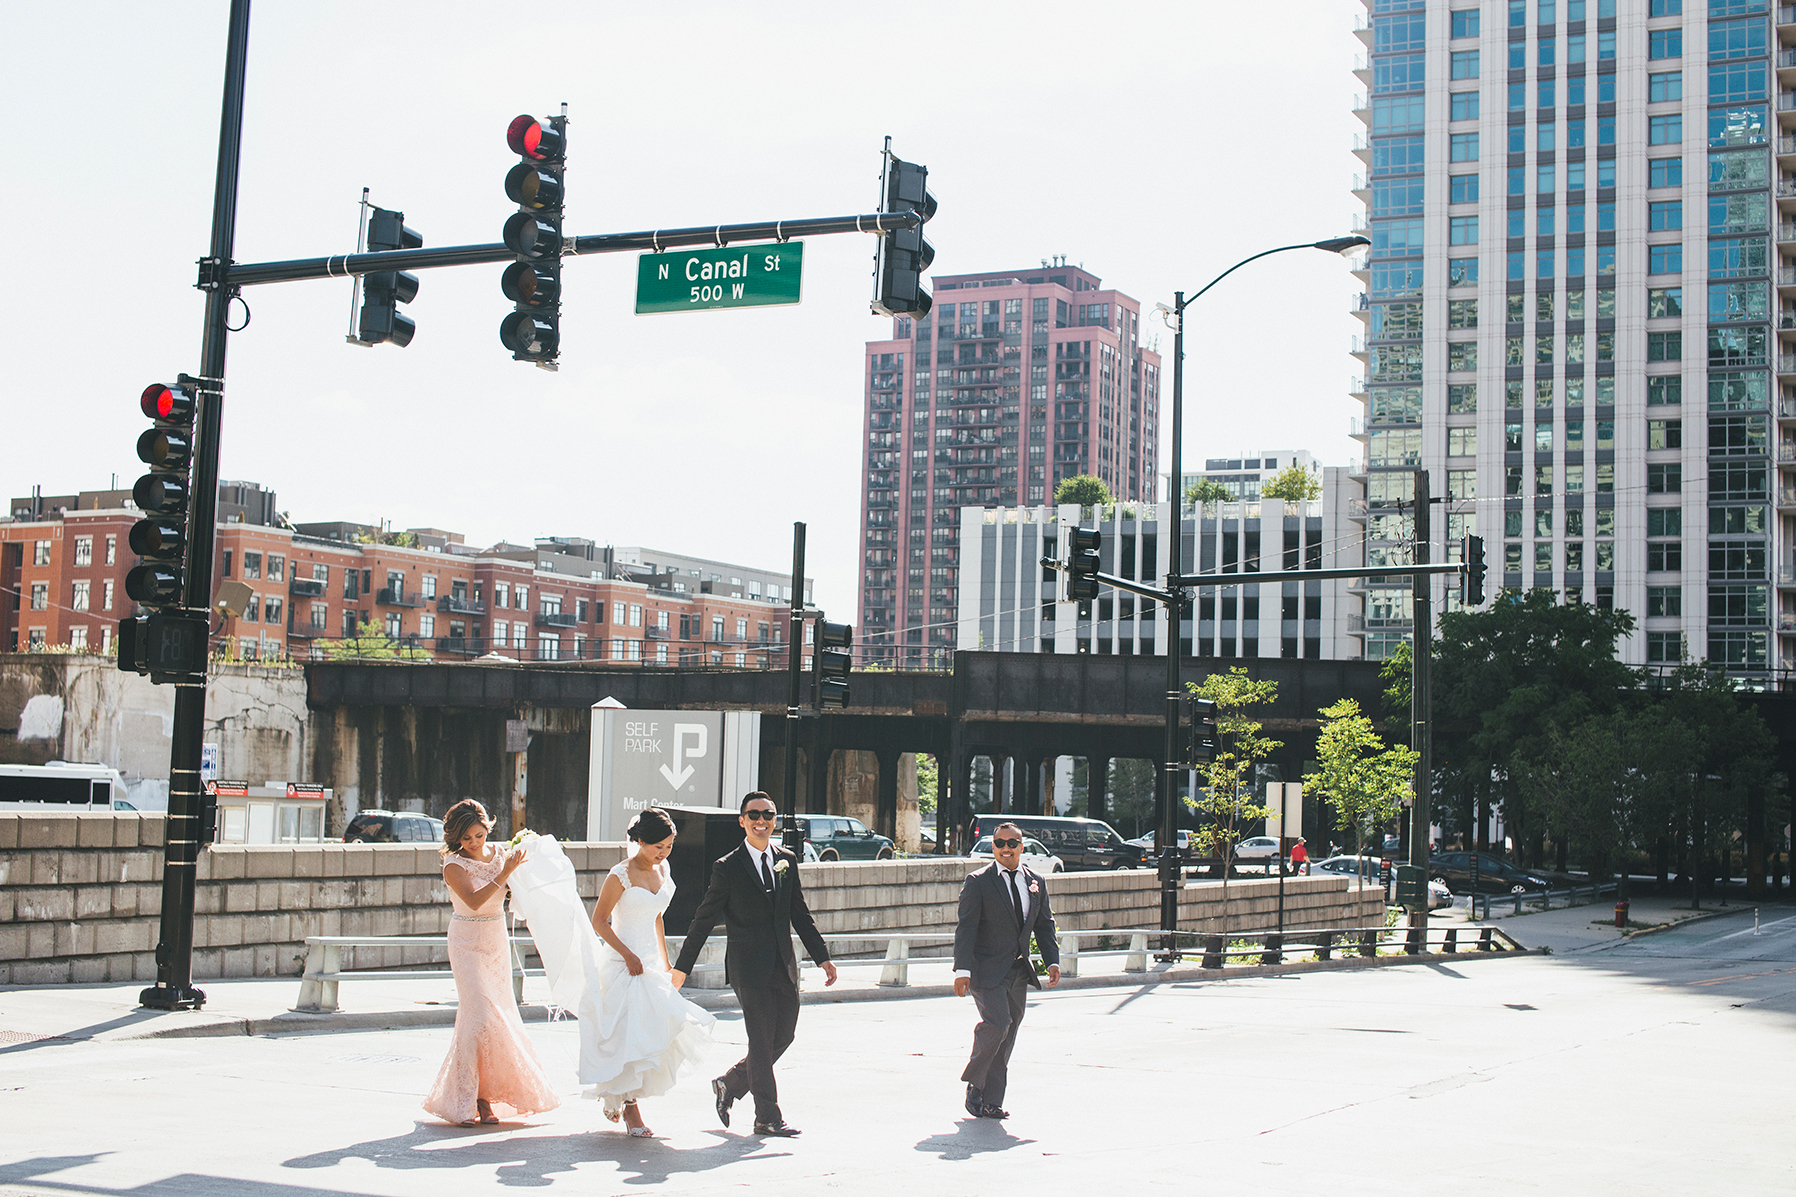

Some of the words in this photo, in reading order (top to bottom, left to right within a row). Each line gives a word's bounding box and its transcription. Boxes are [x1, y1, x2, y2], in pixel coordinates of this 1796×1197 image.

[658, 263, 669, 280] N
[685, 254, 749, 281] Canal
[763, 254, 780, 272] St
[690, 285, 722, 303] 500
[732, 283, 744, 300] W
[625, 722, 659, 737] SELF
[625, 738, 662, 753] PARK
[623, 797, 648, 810] Mart
